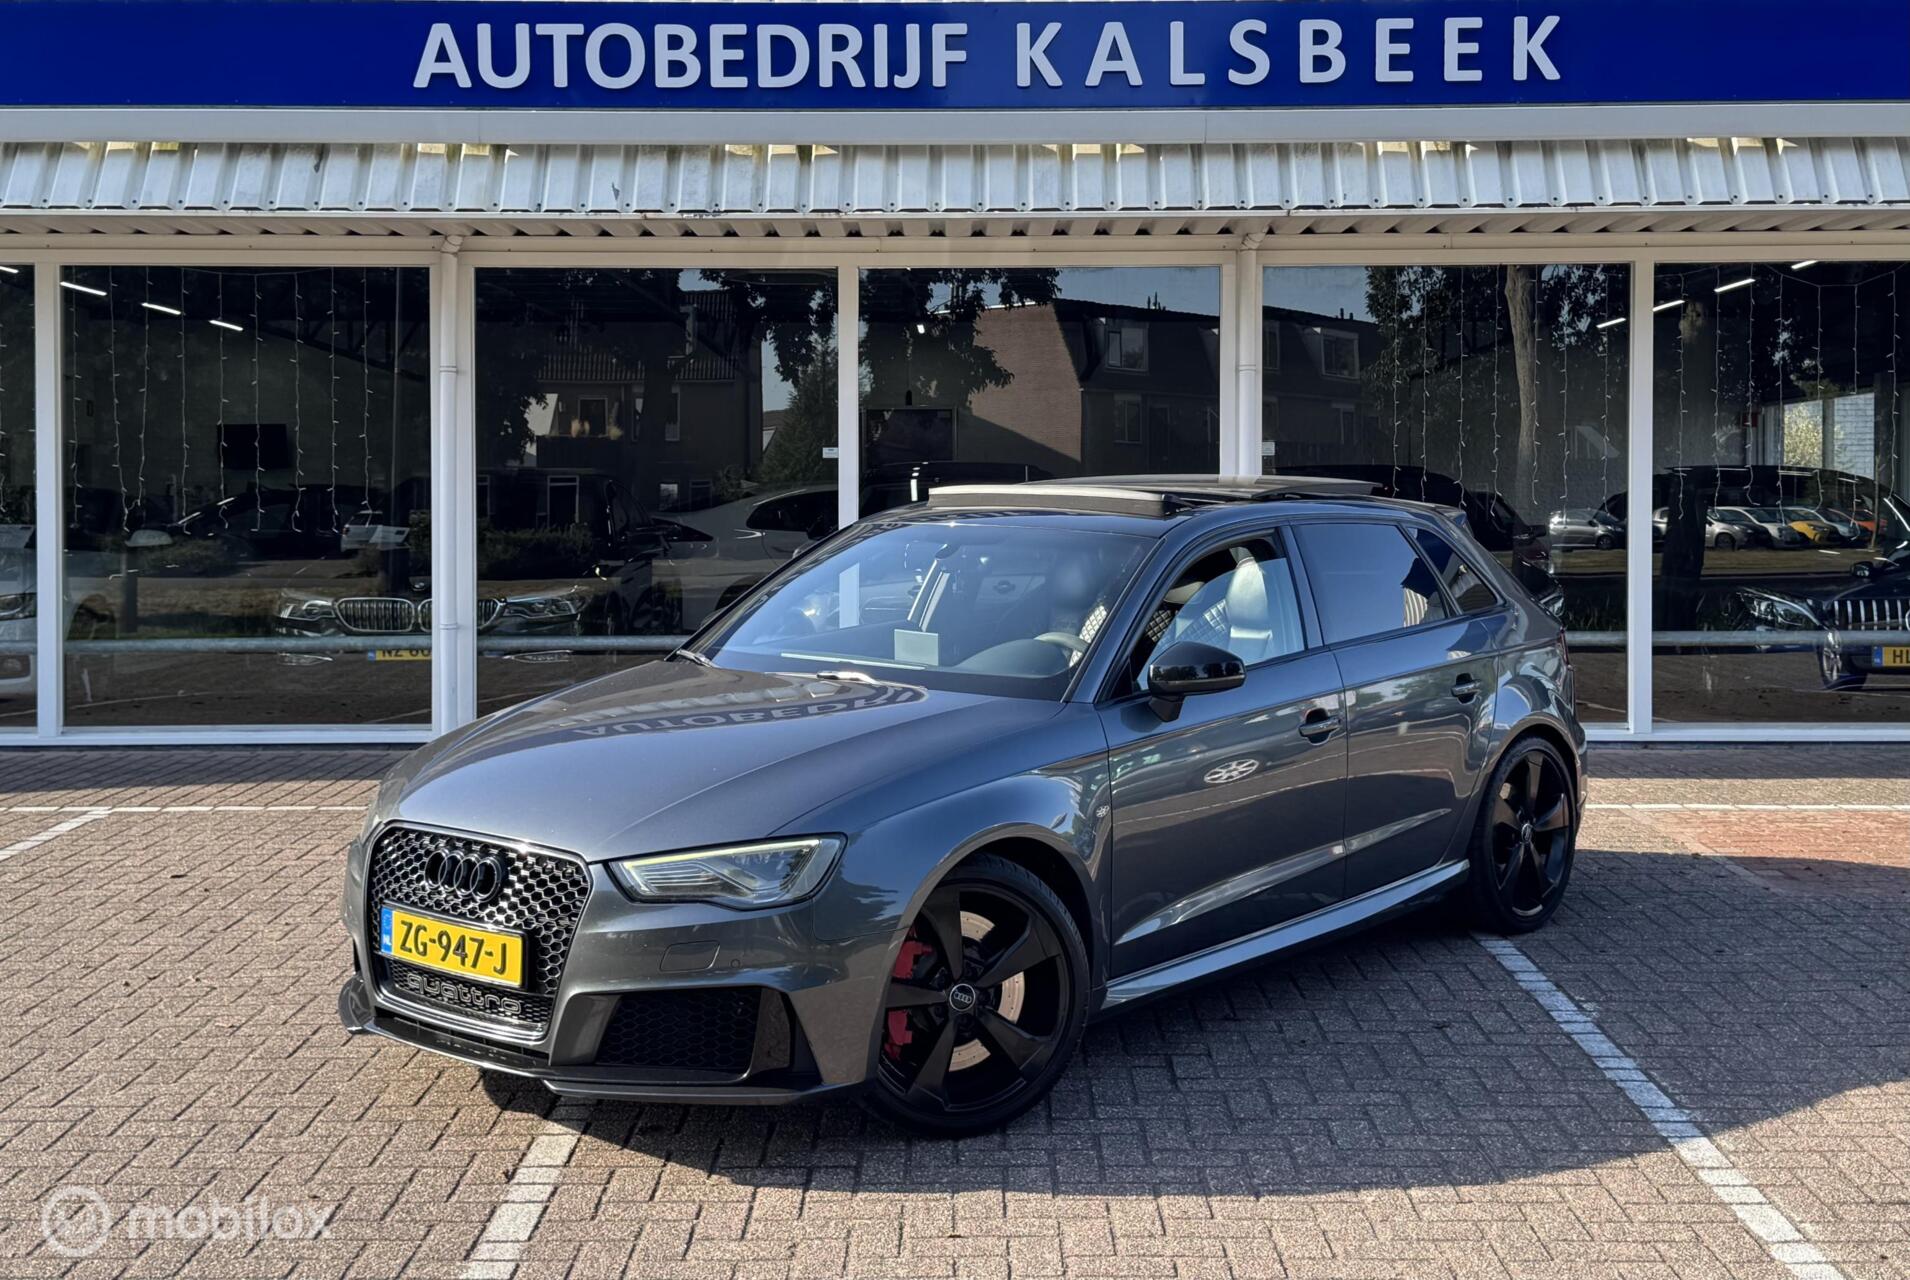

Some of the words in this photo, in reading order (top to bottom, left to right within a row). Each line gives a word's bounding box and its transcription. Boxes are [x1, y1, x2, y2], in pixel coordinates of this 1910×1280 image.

[413, 22, 968, 90] AUTOBEDRIJF
[1015, 15, 1561, 88] KALSBEEK
[399, 919, 508, 975] ZG-947-J
[407, 973, 522, 1015] quattro
